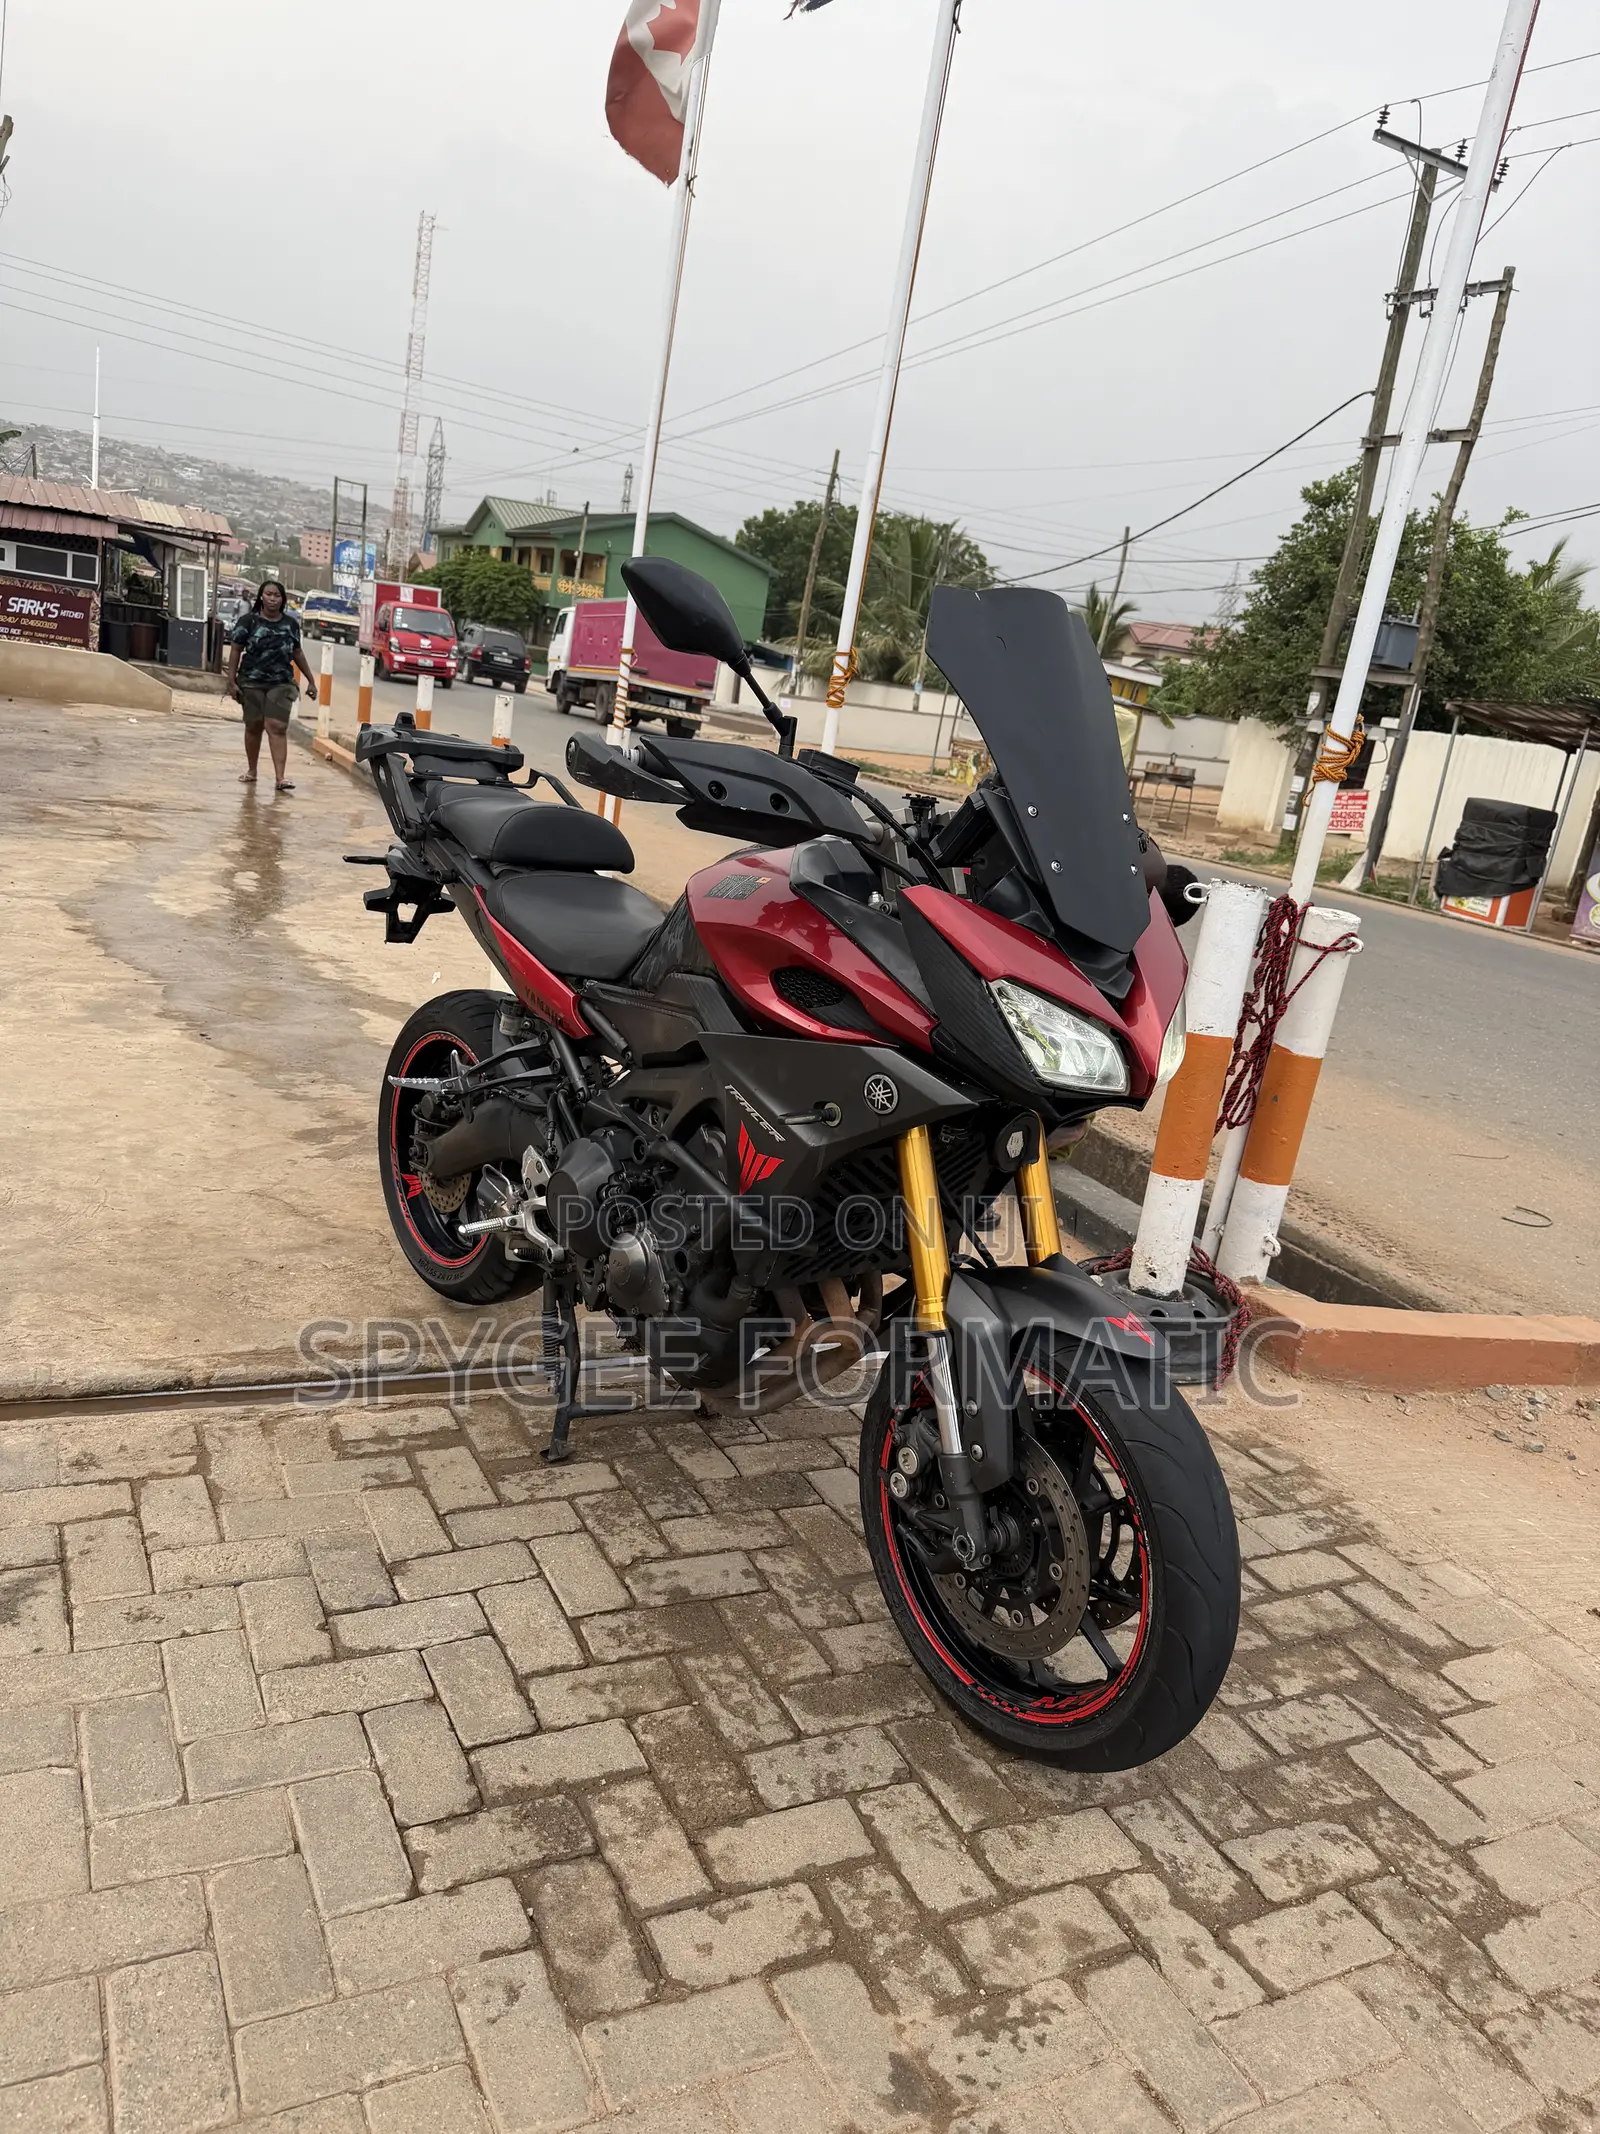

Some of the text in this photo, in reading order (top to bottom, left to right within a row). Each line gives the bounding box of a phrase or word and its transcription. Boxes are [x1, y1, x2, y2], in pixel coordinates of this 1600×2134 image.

[7, 597, 60, 618] SARK'S
[60, 610, 84, 619] KITCHEN
[525, 986, 565, 1028] YAMAHA
[725, 1084, 786, 1142] TRACER
